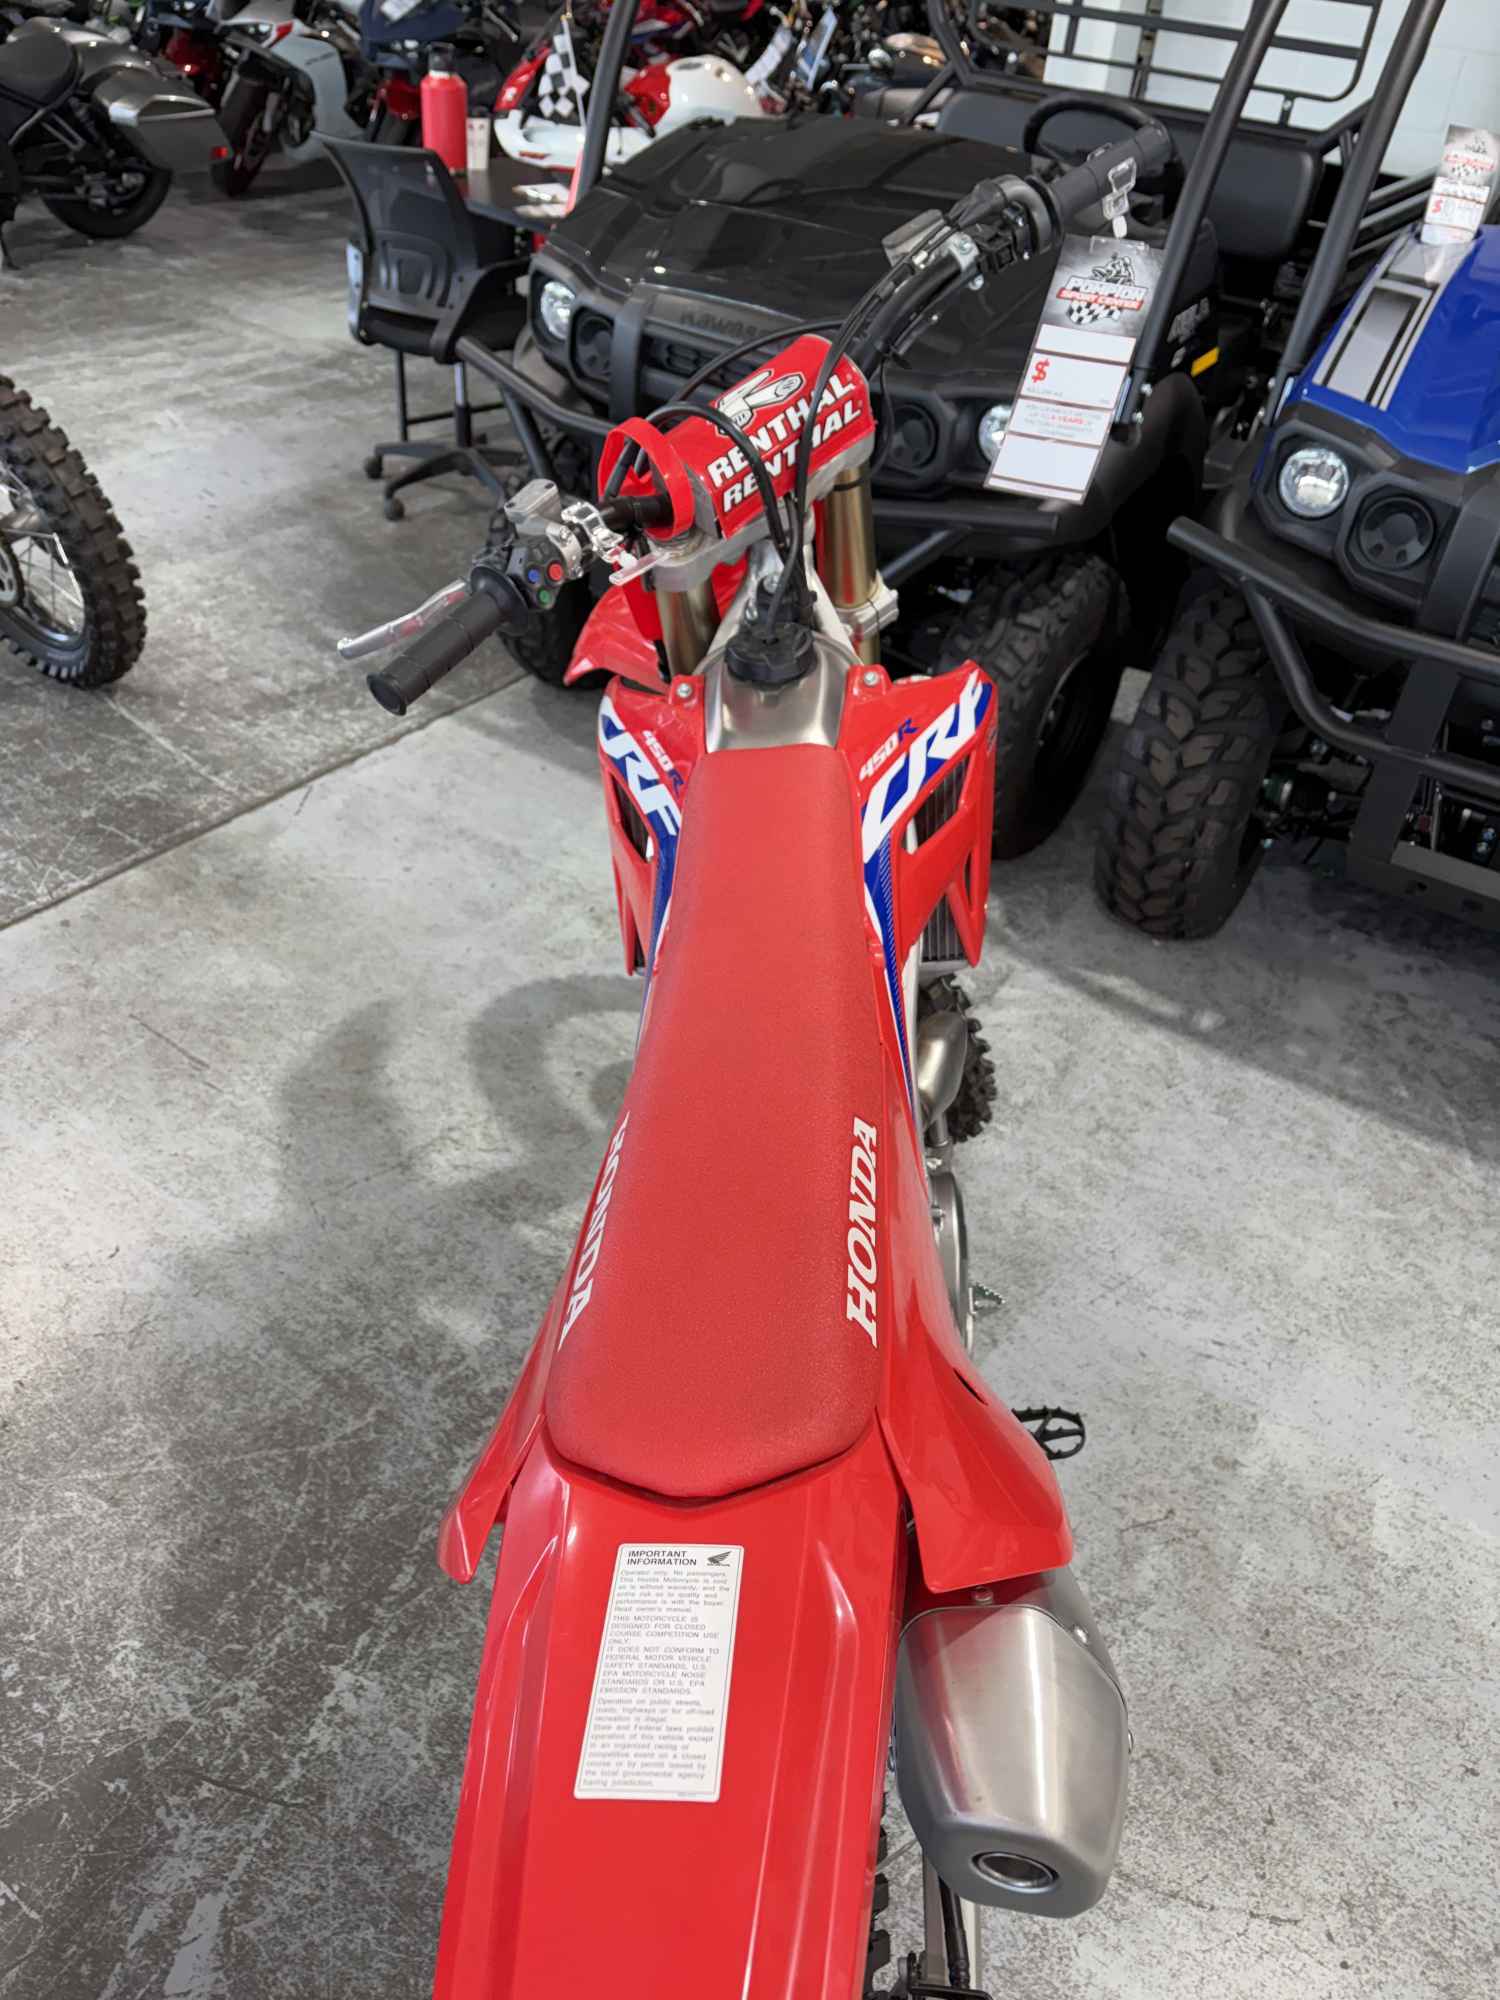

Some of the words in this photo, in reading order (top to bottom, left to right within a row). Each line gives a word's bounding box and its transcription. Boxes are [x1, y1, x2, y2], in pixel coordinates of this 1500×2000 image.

[1031, 358, 1050, 383] $
[599, 696, 682, 836] CRF
[859, 717, 919, 782] 450R
[861, 669, 983, 864] CRF
[846, 1116, 878, 1349] HONDA
